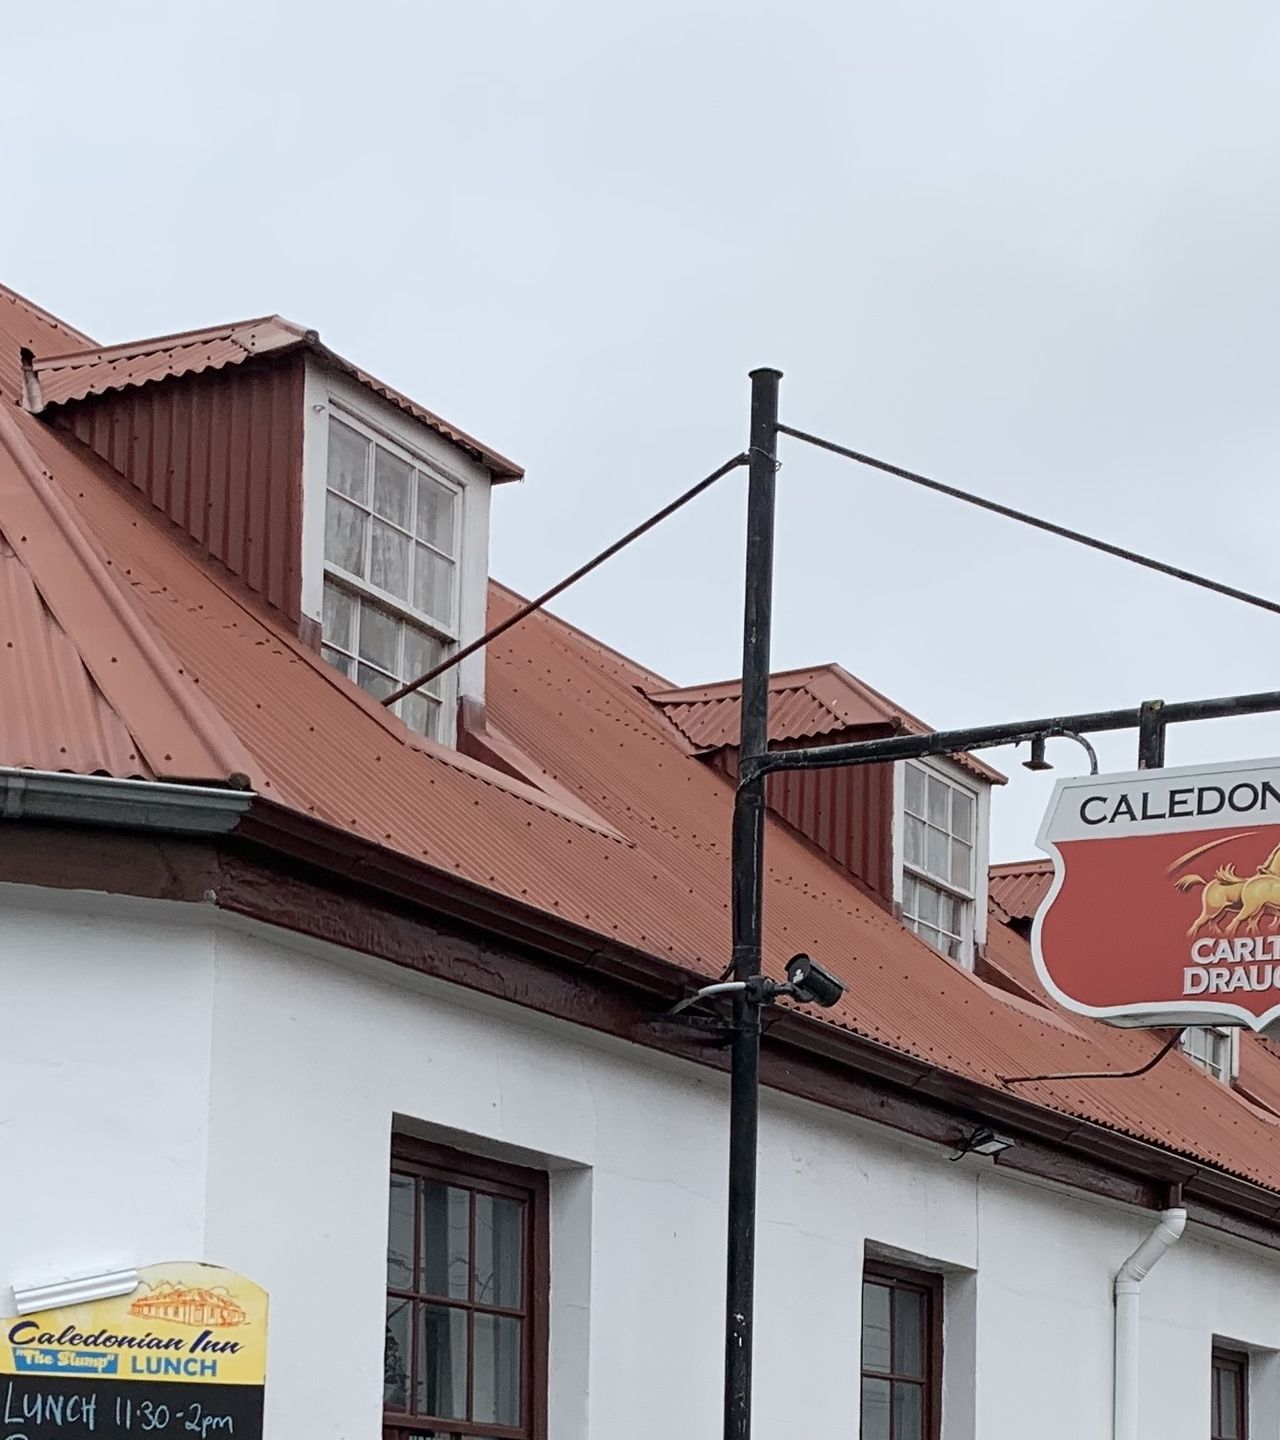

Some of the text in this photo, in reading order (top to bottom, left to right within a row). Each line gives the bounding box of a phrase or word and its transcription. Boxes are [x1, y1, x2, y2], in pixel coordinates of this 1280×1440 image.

[8, 1321, 244, 1354] Caledonian Inn
[131, 1355, 217, 1377] LUNCH
[3, 1381, 96, 1431] LUNCH
